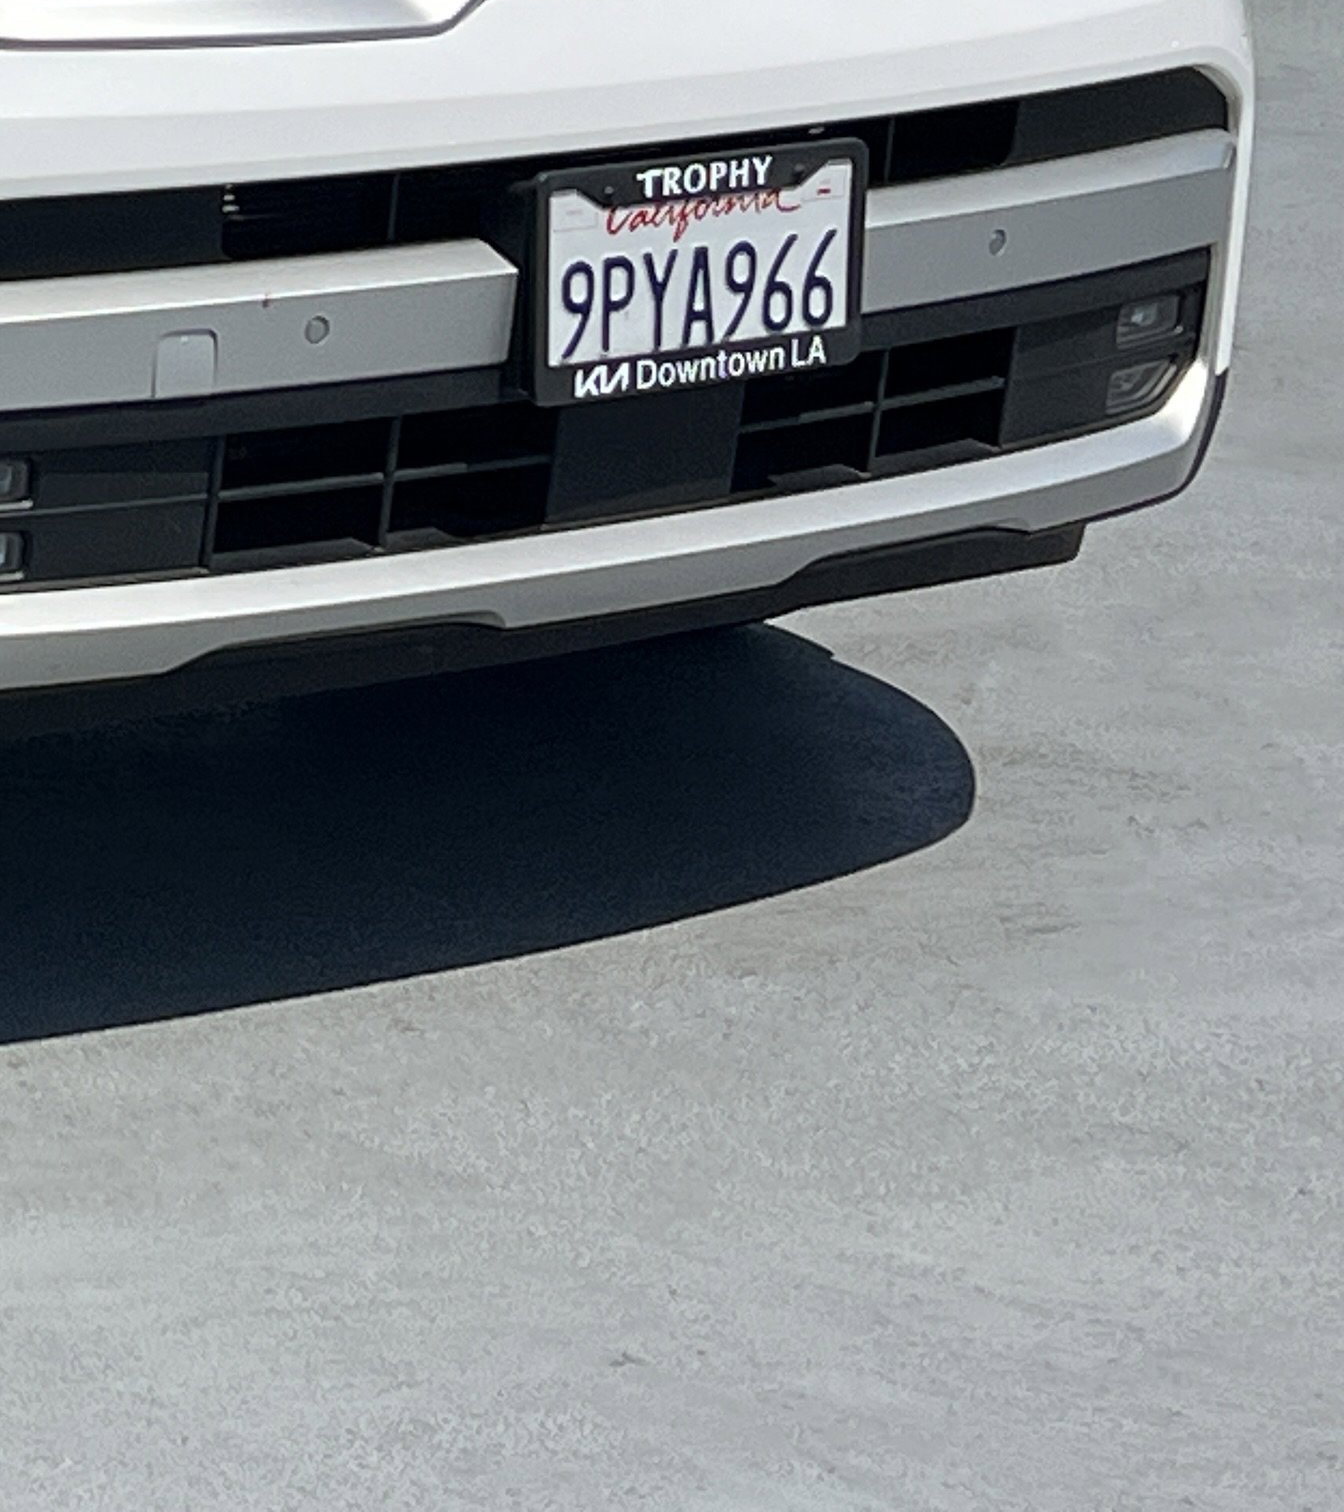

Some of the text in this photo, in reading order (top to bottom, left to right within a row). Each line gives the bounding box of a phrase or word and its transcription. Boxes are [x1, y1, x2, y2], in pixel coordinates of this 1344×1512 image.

[636, 155, 773, 199] TROPHY
[560, 229, 838, 361] 9PYA966
[636, 345, 785, 389] Downtown
[792, 336, 827, 368] LA
